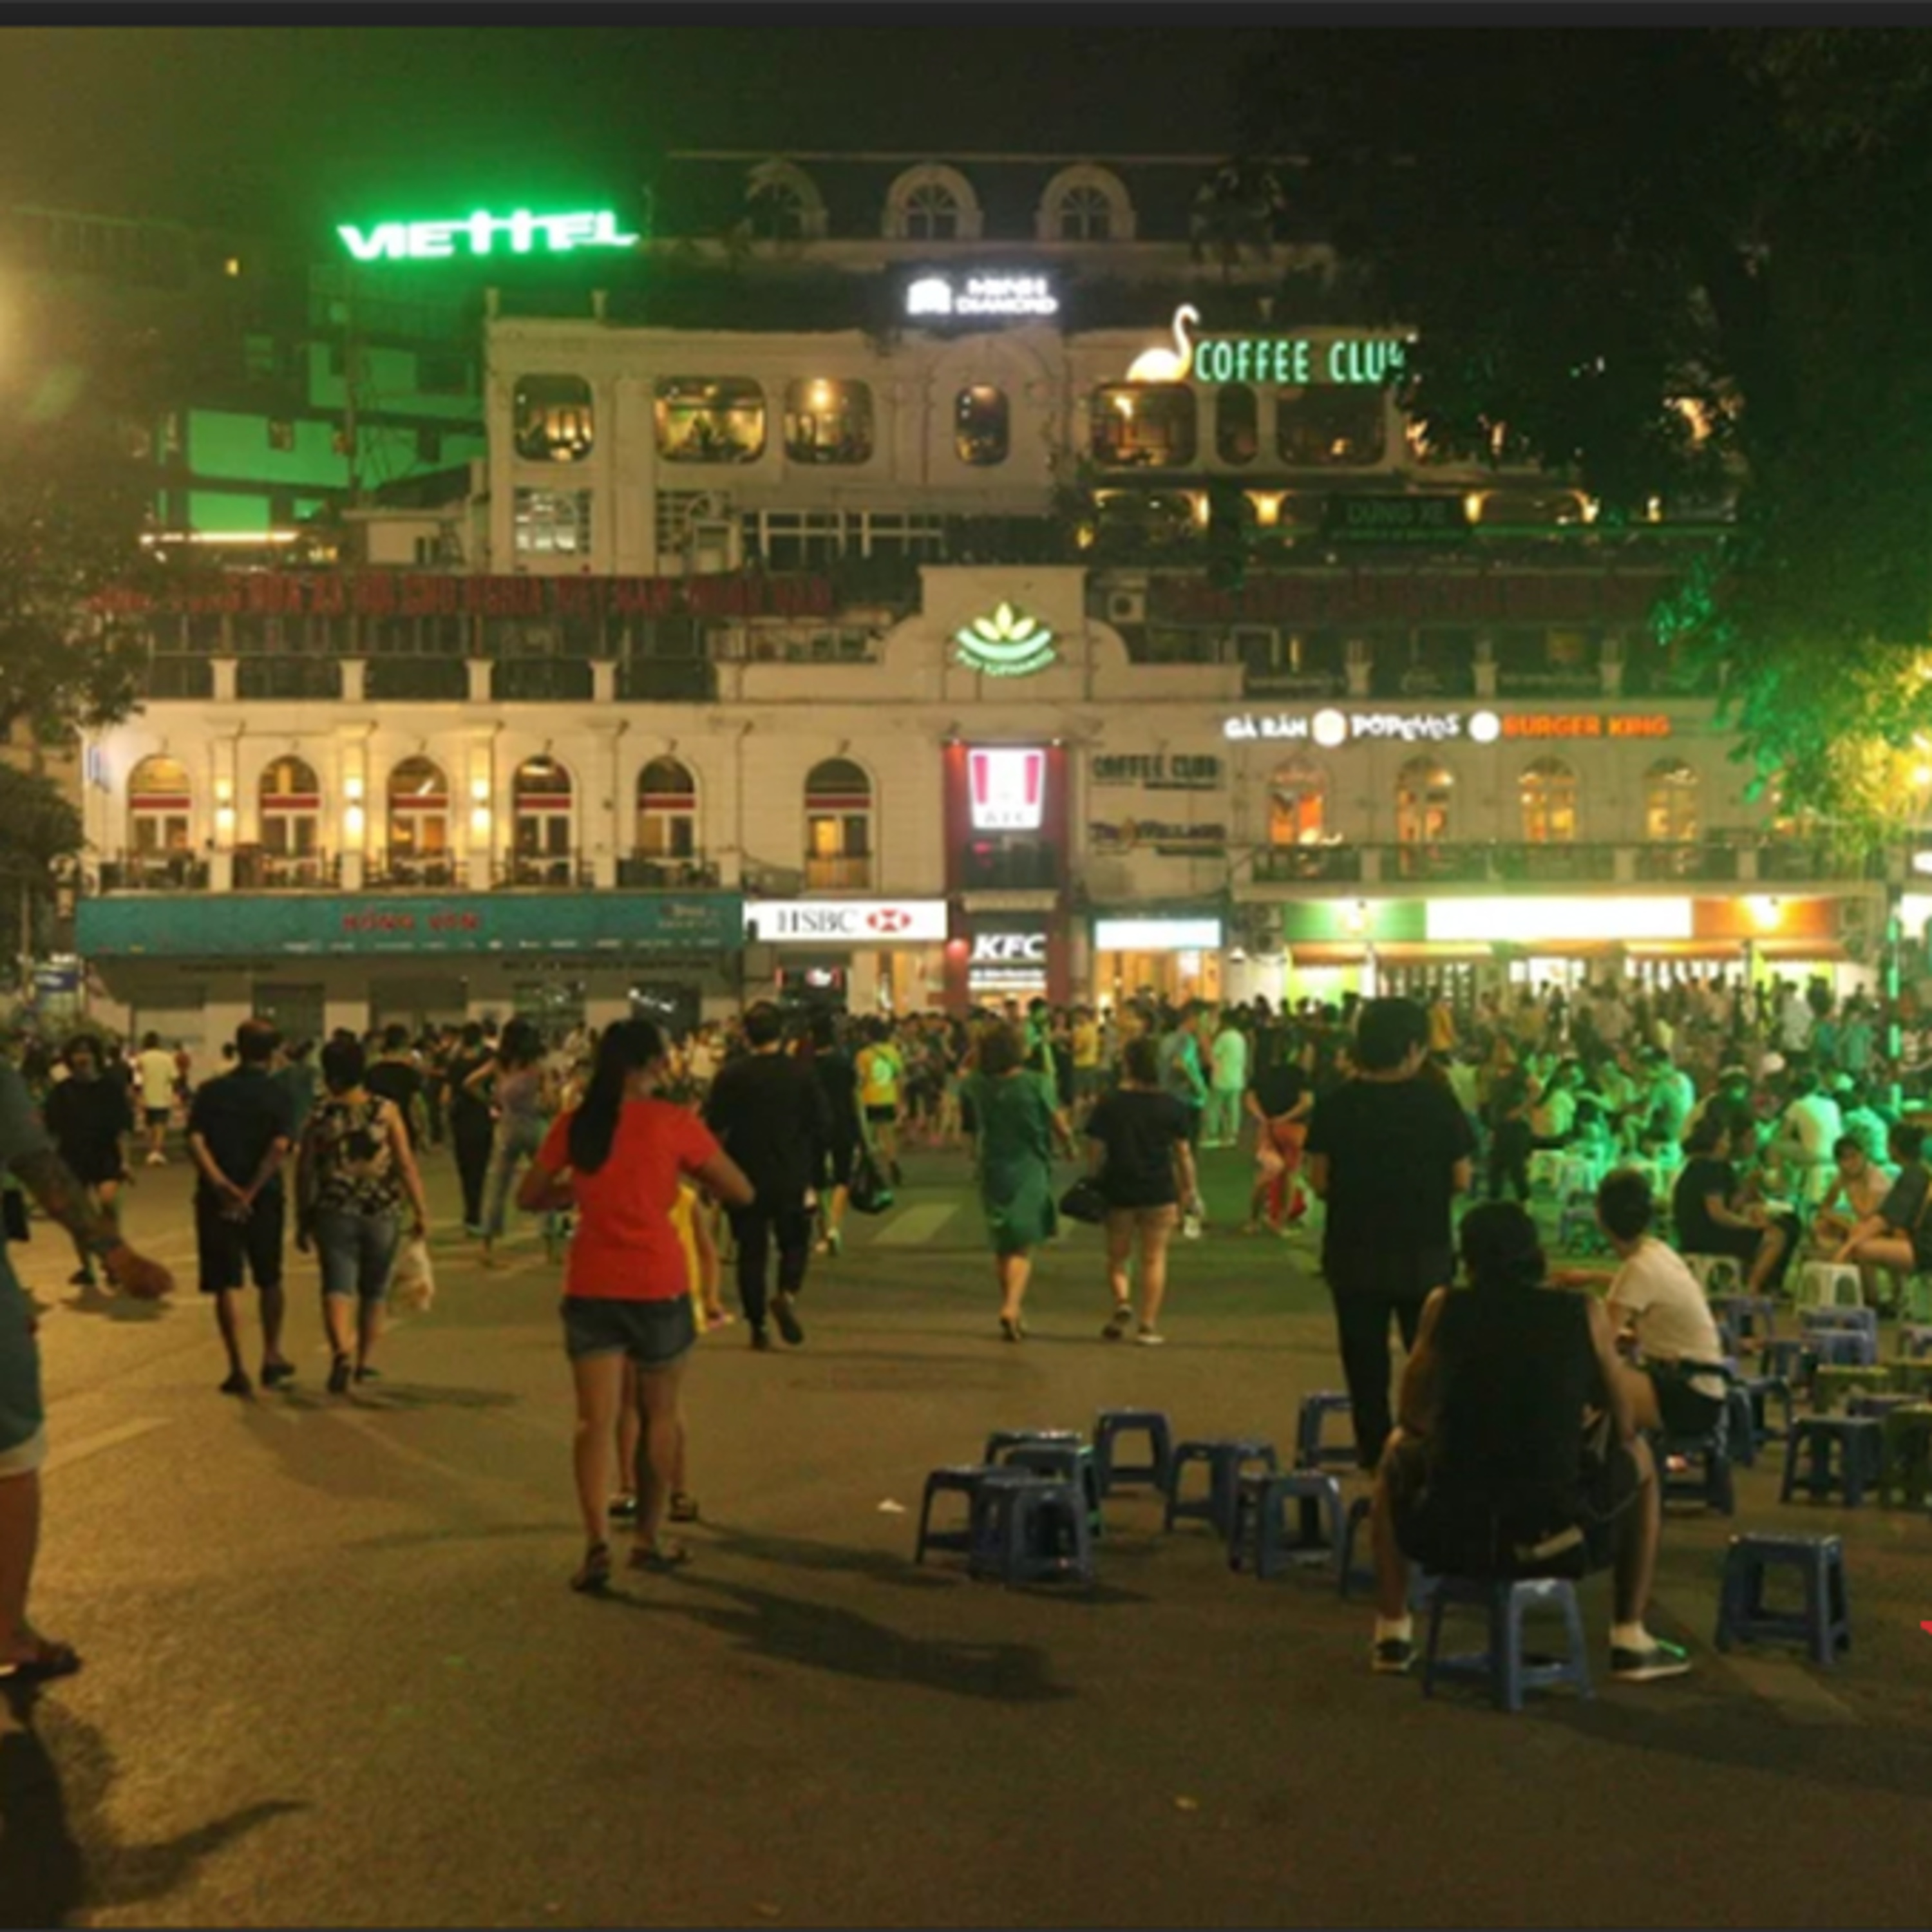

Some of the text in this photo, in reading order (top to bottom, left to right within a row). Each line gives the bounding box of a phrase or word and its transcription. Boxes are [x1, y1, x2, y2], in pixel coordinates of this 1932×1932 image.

[336, 208, 639, 260] VIETTEL
[1195, 340, 1309, 383] COFFEE
[1502, 715, 1600, 737] BURGER
[1609, 715, 1671, 737] KING
[776, 907, 859, 934] HSBC
[970, 933, 1047, 960] KFC
